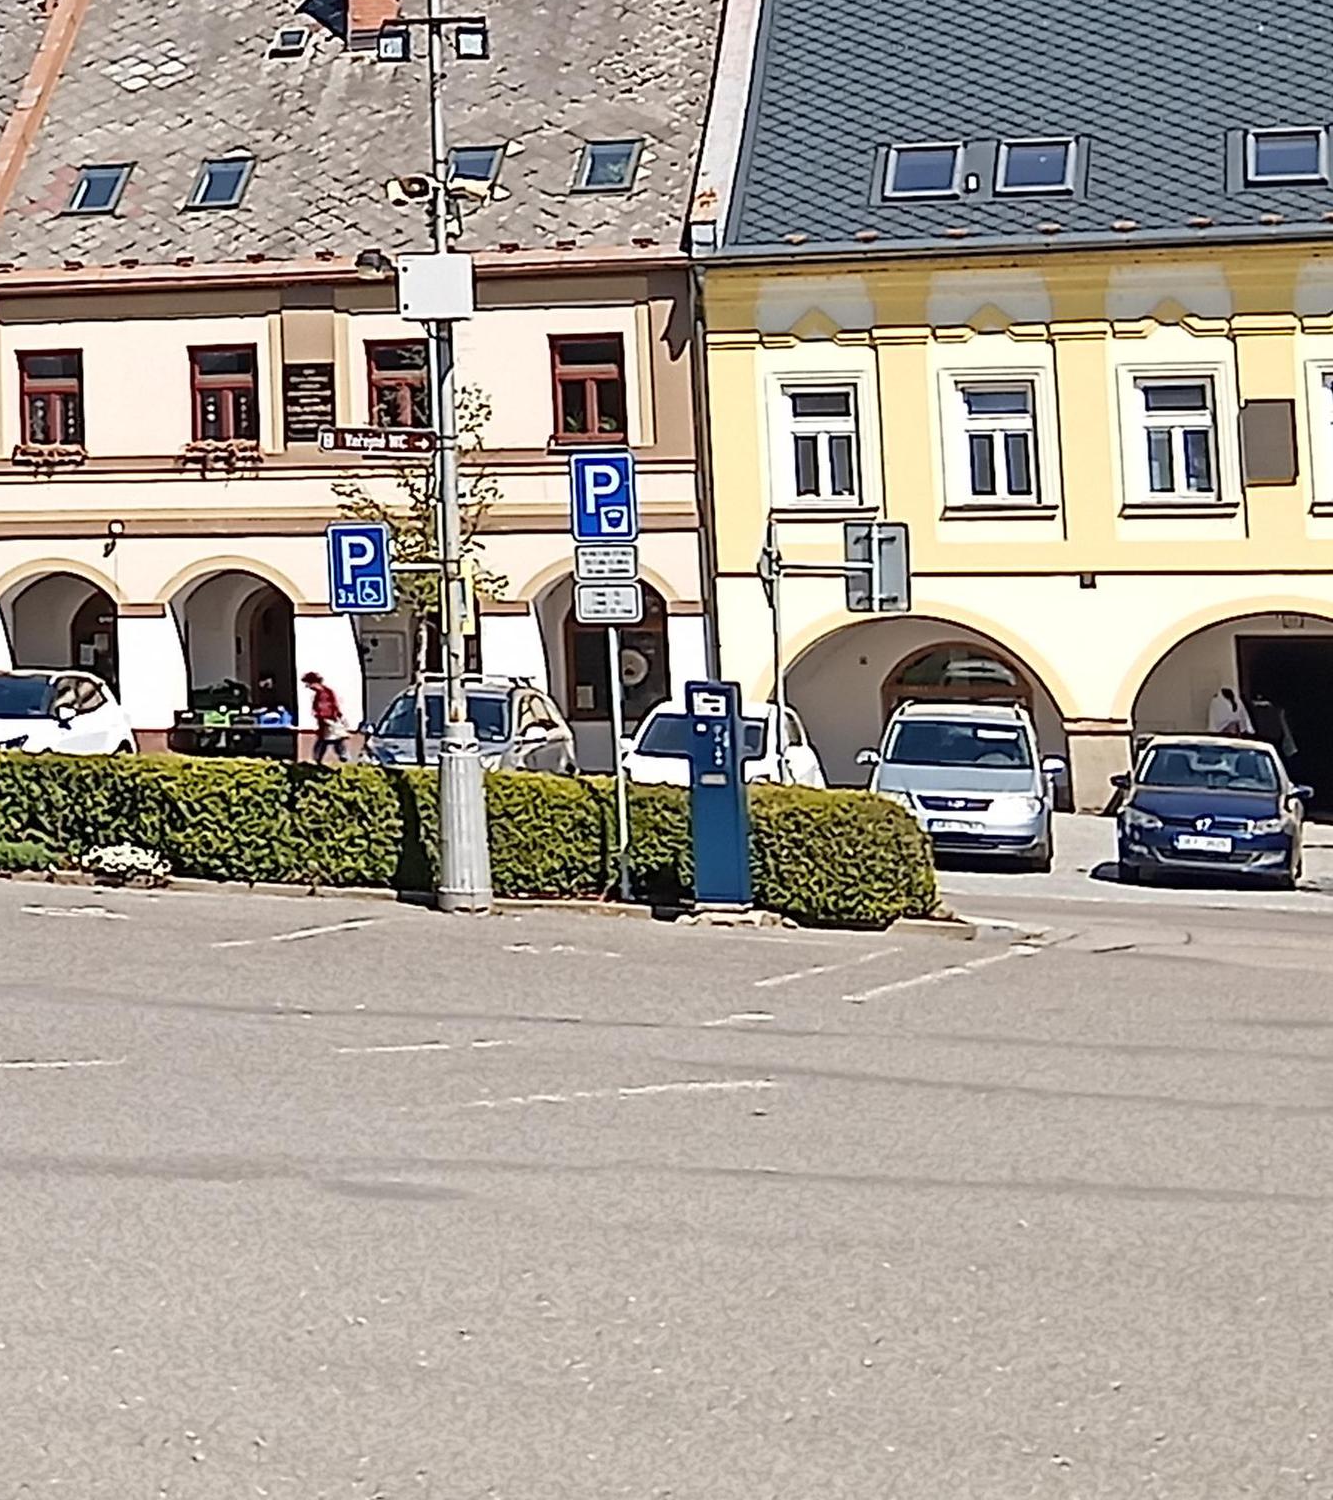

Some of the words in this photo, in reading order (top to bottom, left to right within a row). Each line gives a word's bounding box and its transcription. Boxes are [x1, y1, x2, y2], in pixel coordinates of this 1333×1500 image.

[584, 465, 621, 514] P
[340, 535, 375, 585] P
[337, 588, 356, 604] 3x
